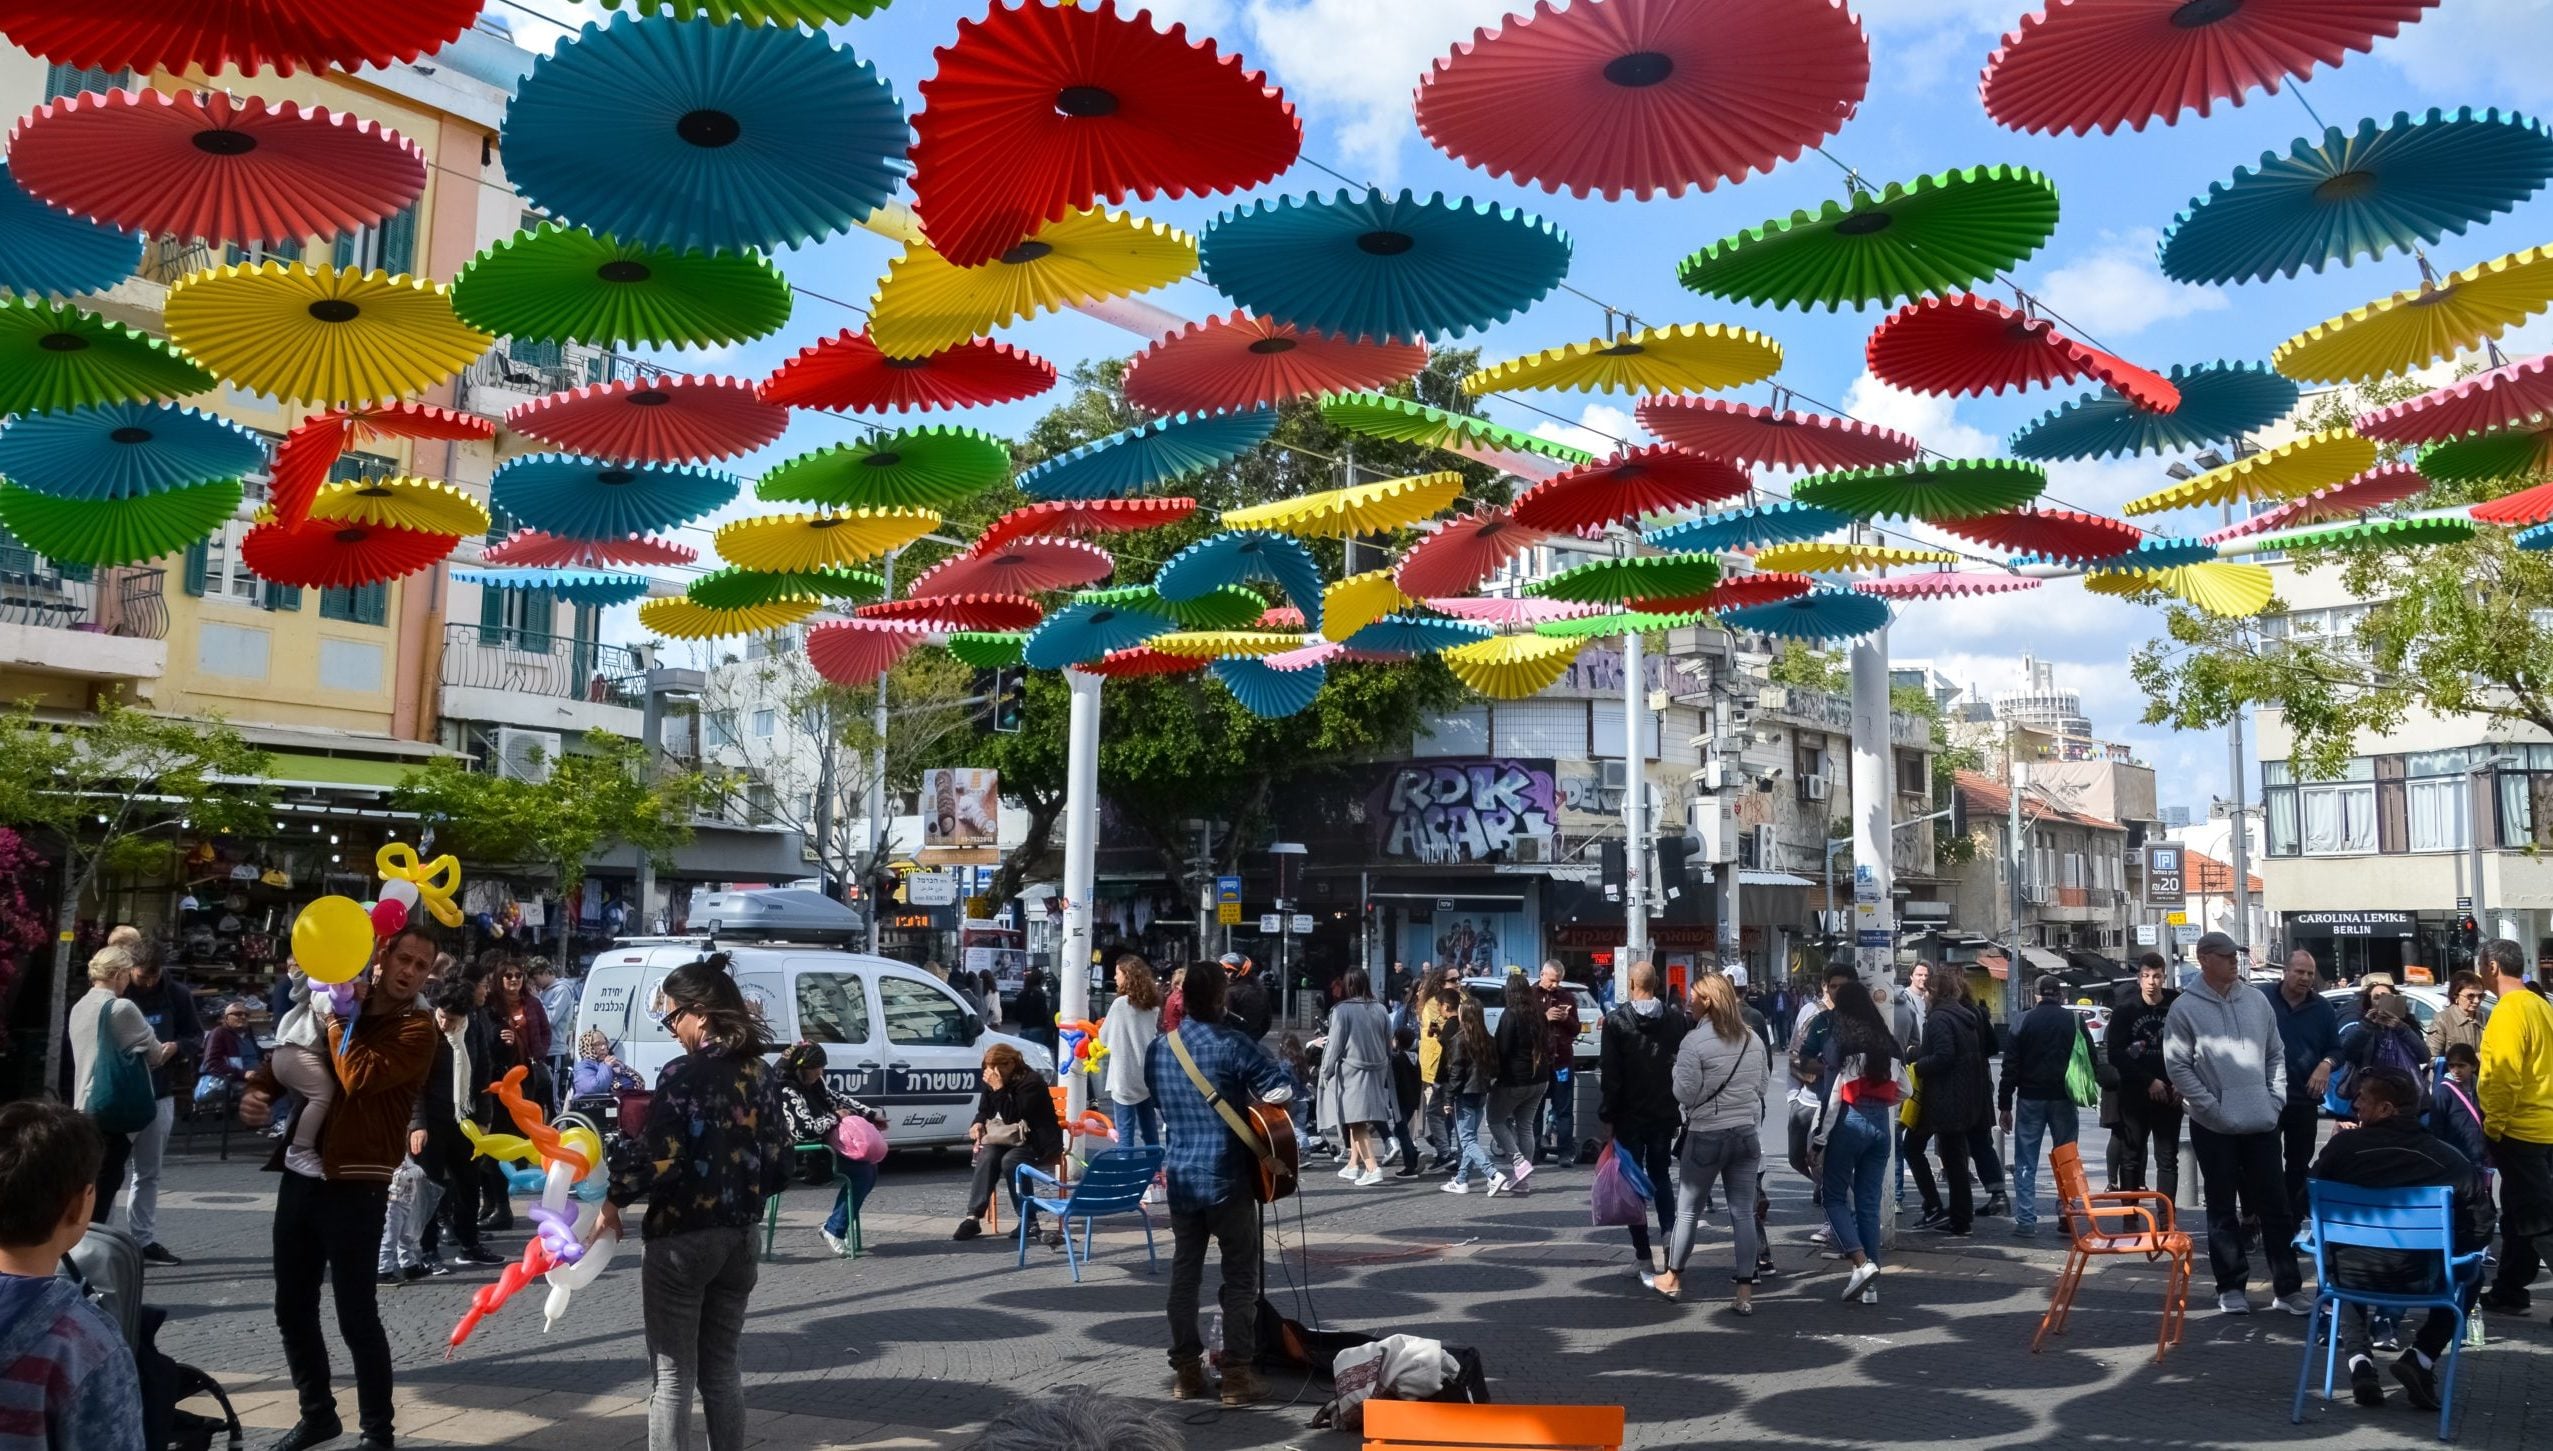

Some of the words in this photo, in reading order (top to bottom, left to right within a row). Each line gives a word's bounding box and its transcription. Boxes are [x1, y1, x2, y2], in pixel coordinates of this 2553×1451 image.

[2160, 877, 2179, 891] 20
[1818, 910, 1848, 932] VBE
[2299, 913, 2360, 924] CAROLINA
[2364, 913, 2408, 924] LEMKE
[2333, 925, 2371, 935] BERLIN
[601, 987, 623, 997] יחידת
[593, 1001, 625, 1013] הכלבנים
[825, 1073, 869, 1093] ישר
[906, 1073, 975, 1092] משטרת
[902, 1112, 948, 1128] الشرطة
